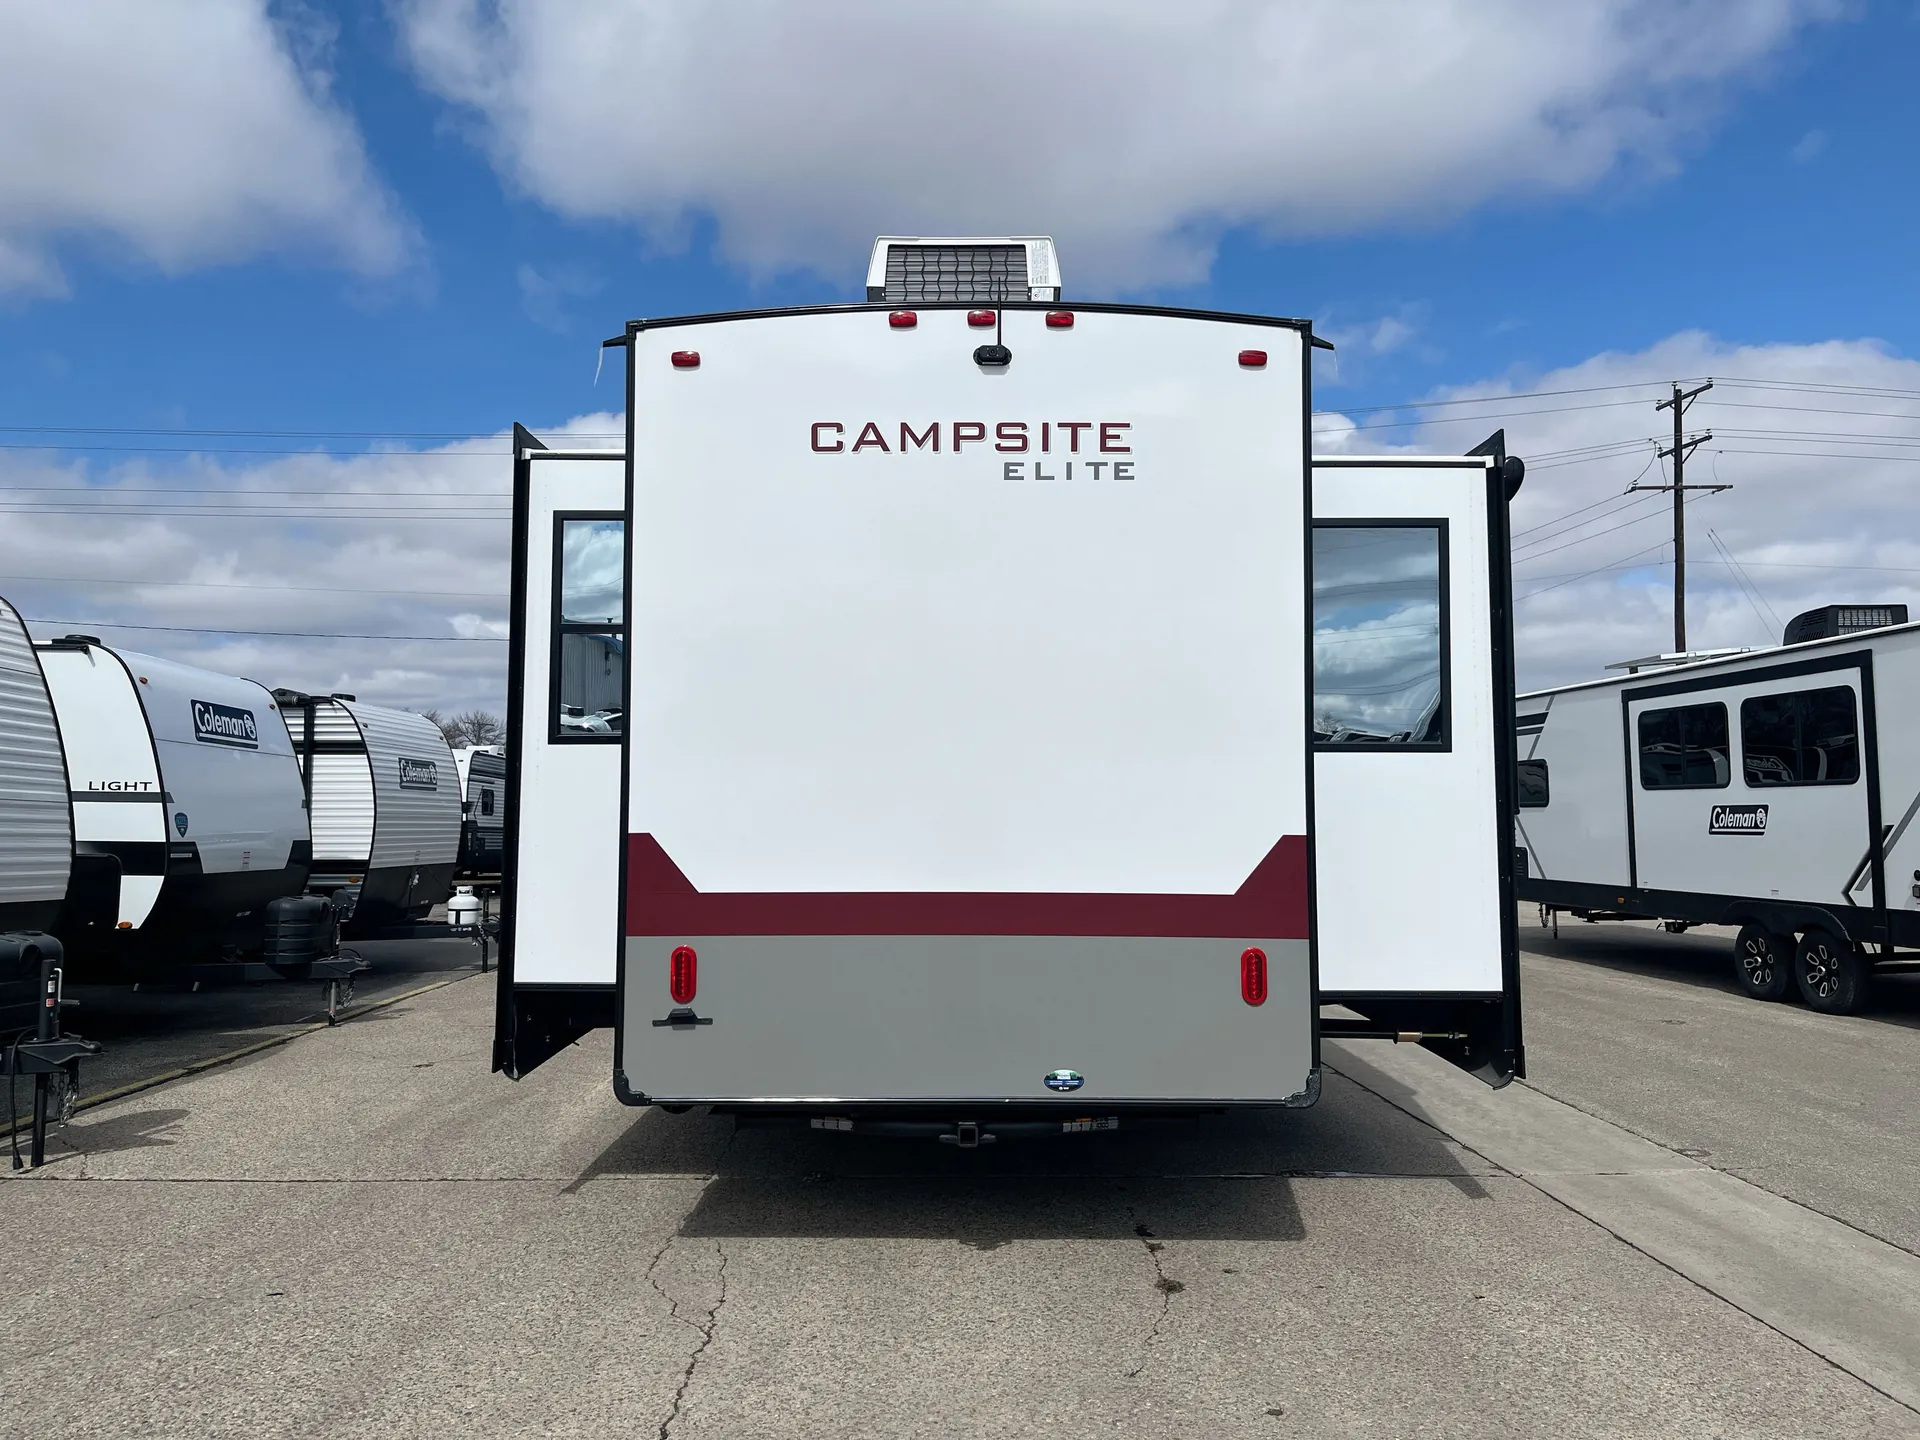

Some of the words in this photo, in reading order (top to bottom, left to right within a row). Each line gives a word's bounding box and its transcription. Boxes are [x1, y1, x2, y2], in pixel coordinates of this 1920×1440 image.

[811, 422, 1132, 453] CAMPSITE
[1003, 461, 1135, 481] ELITE
[194, 703, 246, 737] Coleman
[88, 781, 153, 791] LIGHT
[1712, 807, 1756, 828] Coleman
